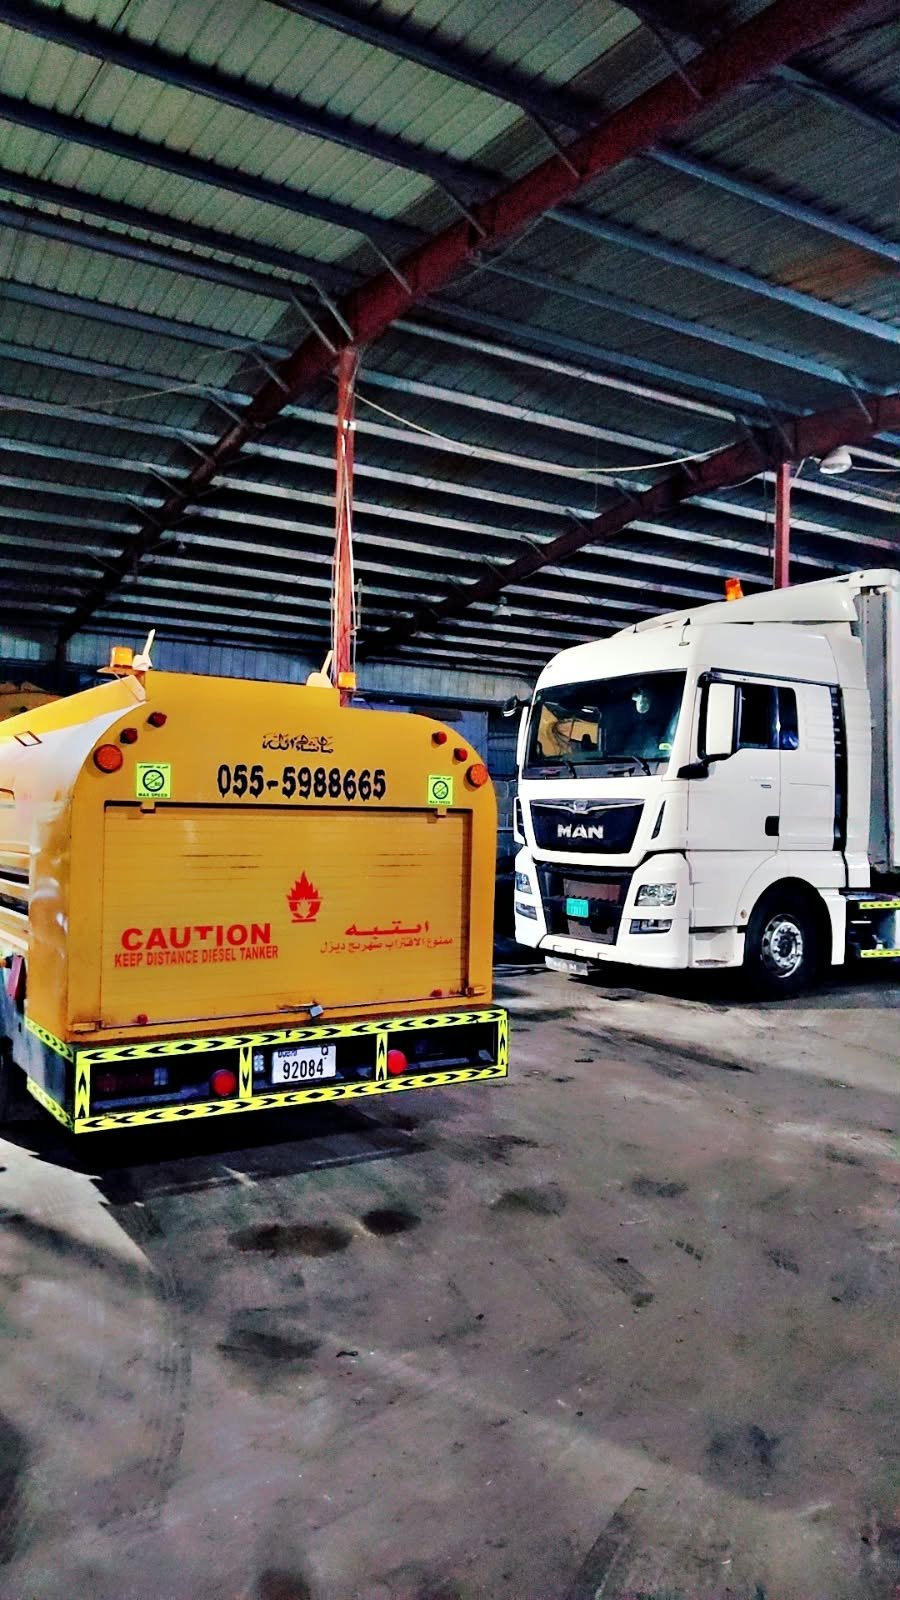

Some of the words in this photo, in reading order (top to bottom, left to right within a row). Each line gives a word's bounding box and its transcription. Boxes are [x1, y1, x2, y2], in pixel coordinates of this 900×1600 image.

[217, 764, 387, 802] 055-5988665
[557, 822, 604, 840] MAN
[121, 923, 271, 951] CAUTION
[114, 953, 143, 968] KEEP
[146, 949, 199, 967] DISTANCE
[202, 948, 237, 963] DIESEL
[239, 945, 279, 961] TANKER
[282, 1058, 325, 1080] 92084
